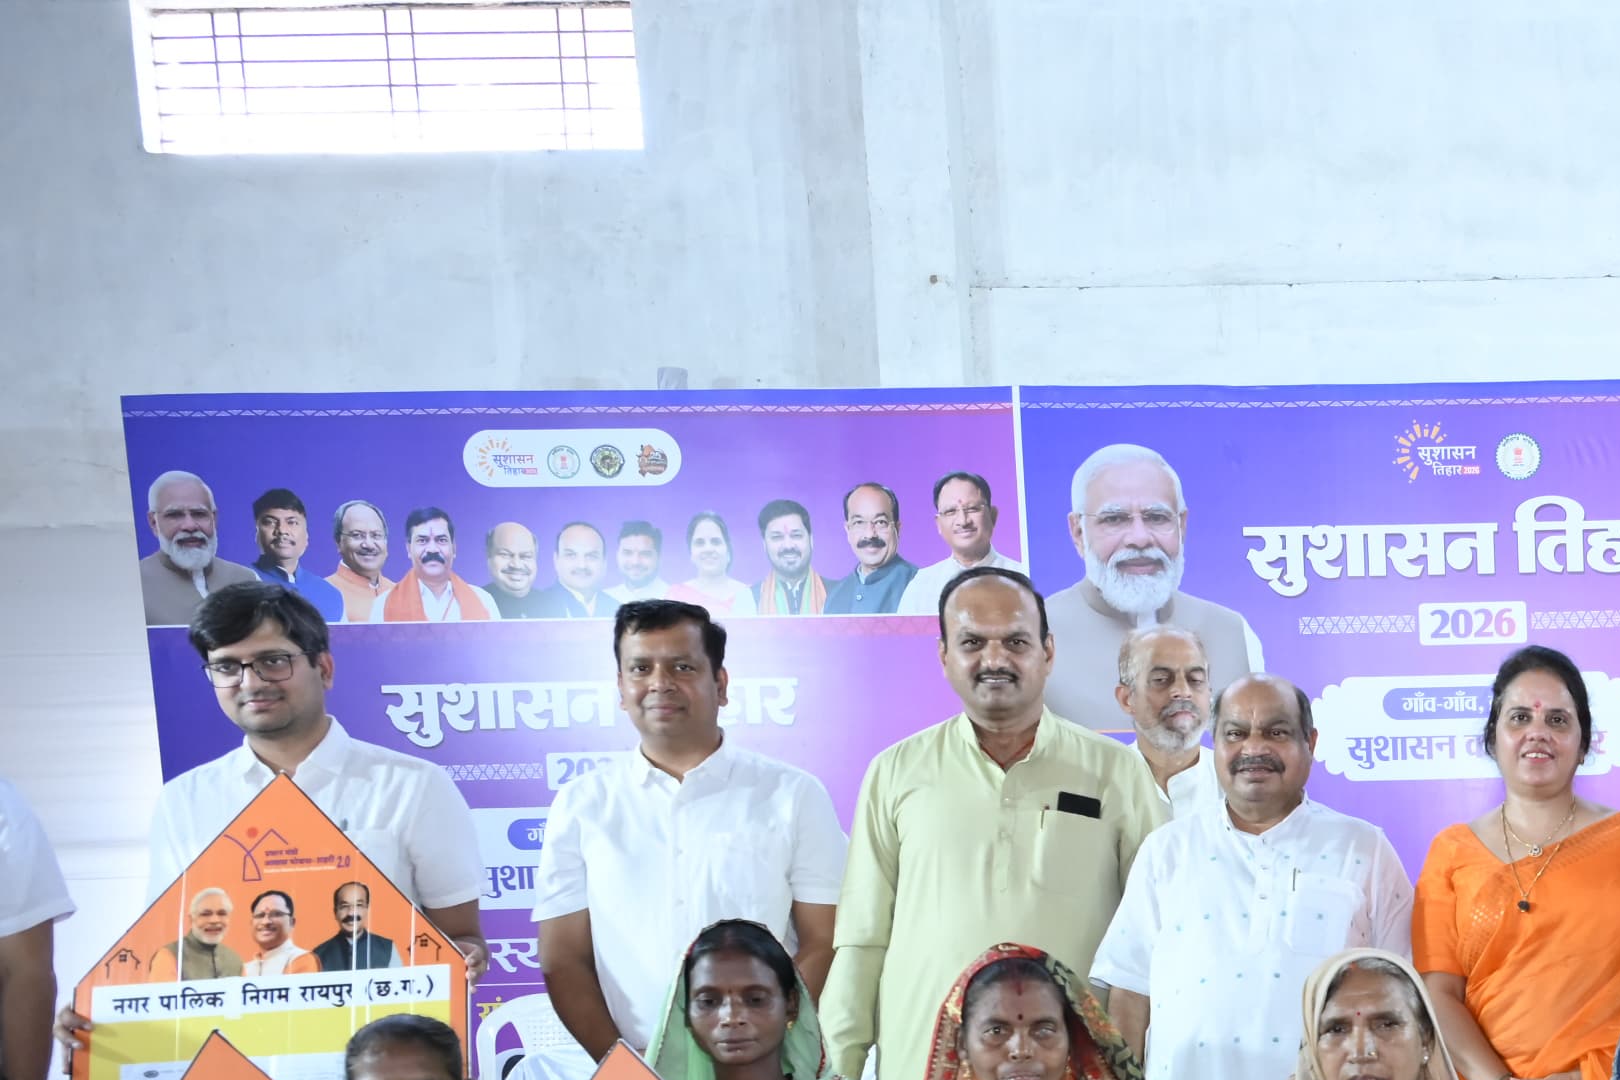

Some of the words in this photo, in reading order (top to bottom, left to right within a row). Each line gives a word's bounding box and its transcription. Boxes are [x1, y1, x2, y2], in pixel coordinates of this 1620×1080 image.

[492, 454, 534, 468] सुशासन
[1417, 446, 1477, 466] सुशासन
[1432, 462, 1463, 476] तिहार
[1242, 519, 1498, 597] सुशासन
[1429, 608, 1516, 638] 2026
[381, 680, 618, 748] सुशासन
[1345, 735, 1456, 769] सुशासन
[114, 998, 149, 1013] नगर
[160, 987, 224, 1009] पालिक
[242, 983, 289, 1004] निगम
[300, 984, 352, 1007] रायपुर
